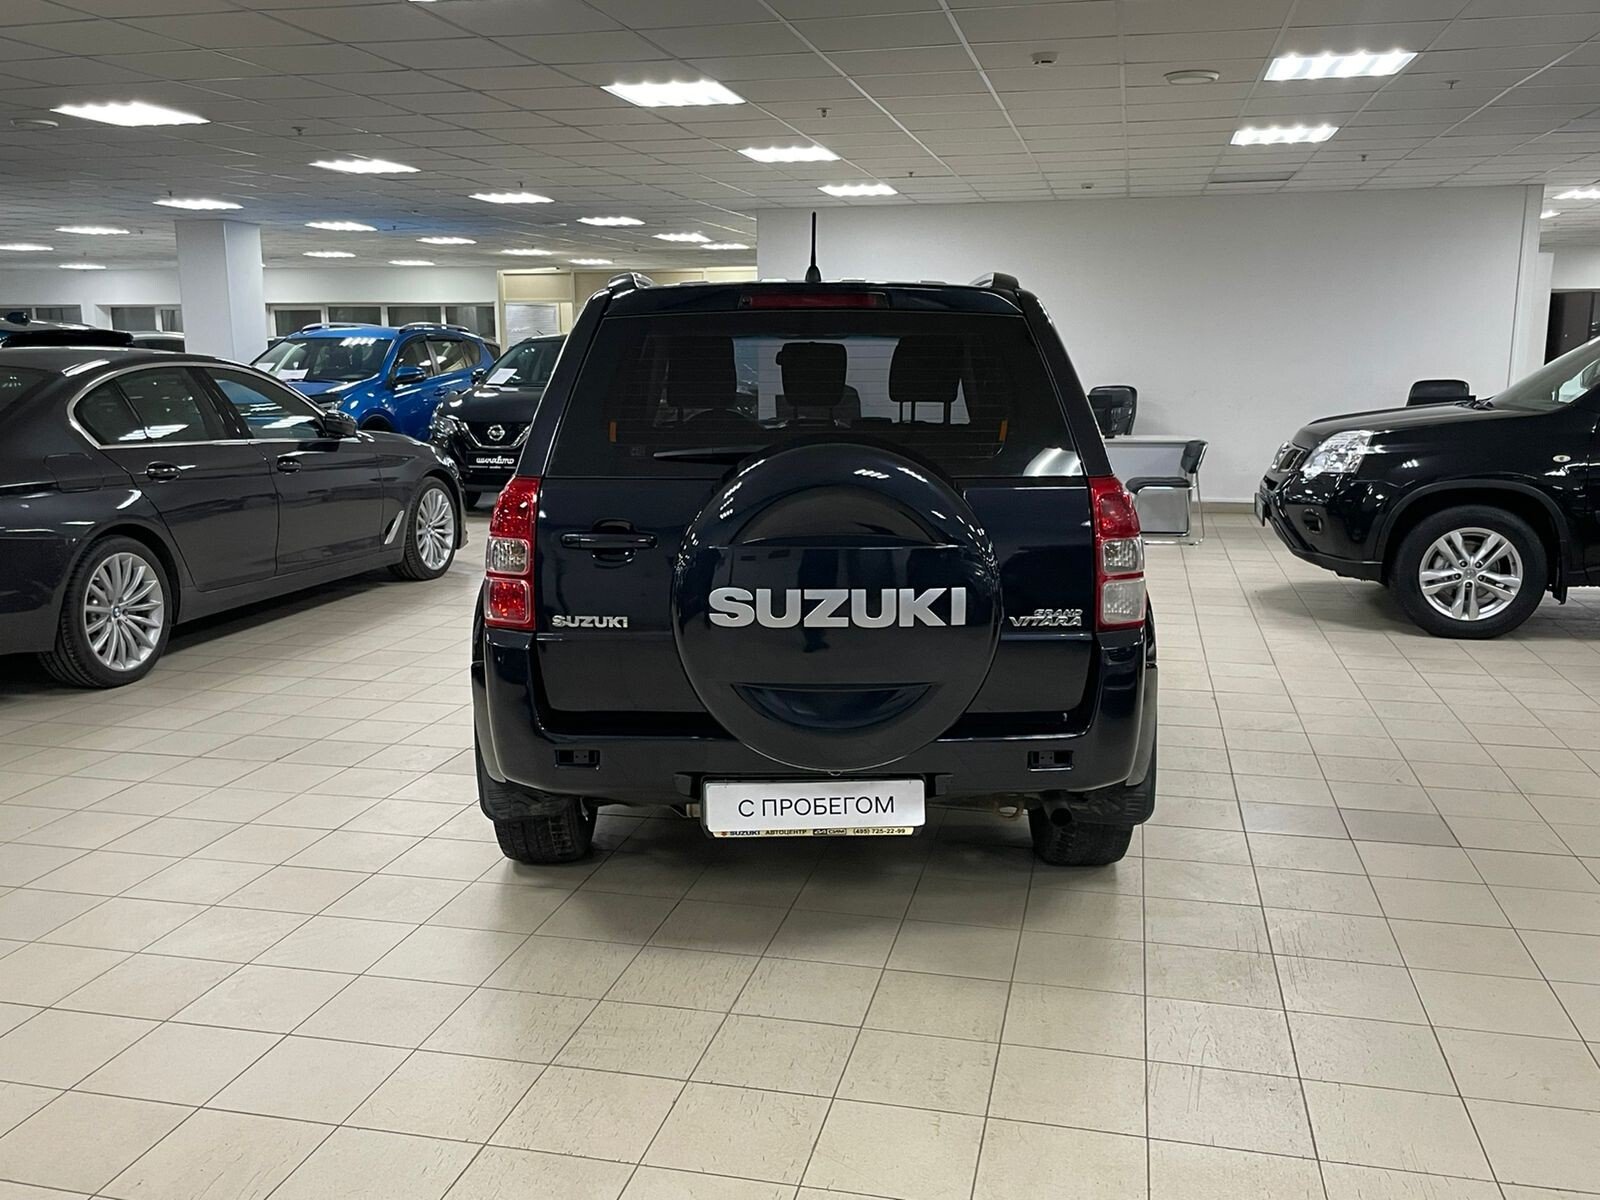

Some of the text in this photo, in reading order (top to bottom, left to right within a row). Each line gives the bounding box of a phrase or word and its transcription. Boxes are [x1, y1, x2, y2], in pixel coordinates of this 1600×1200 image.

[708, 587, 967, 628] SUZUKI
[551, 614, 628, 628] SUZUKI
[1008, 615, 1082, 627] VITARA
[737, 796, 895, 818] С ПРОБЕГОМ
